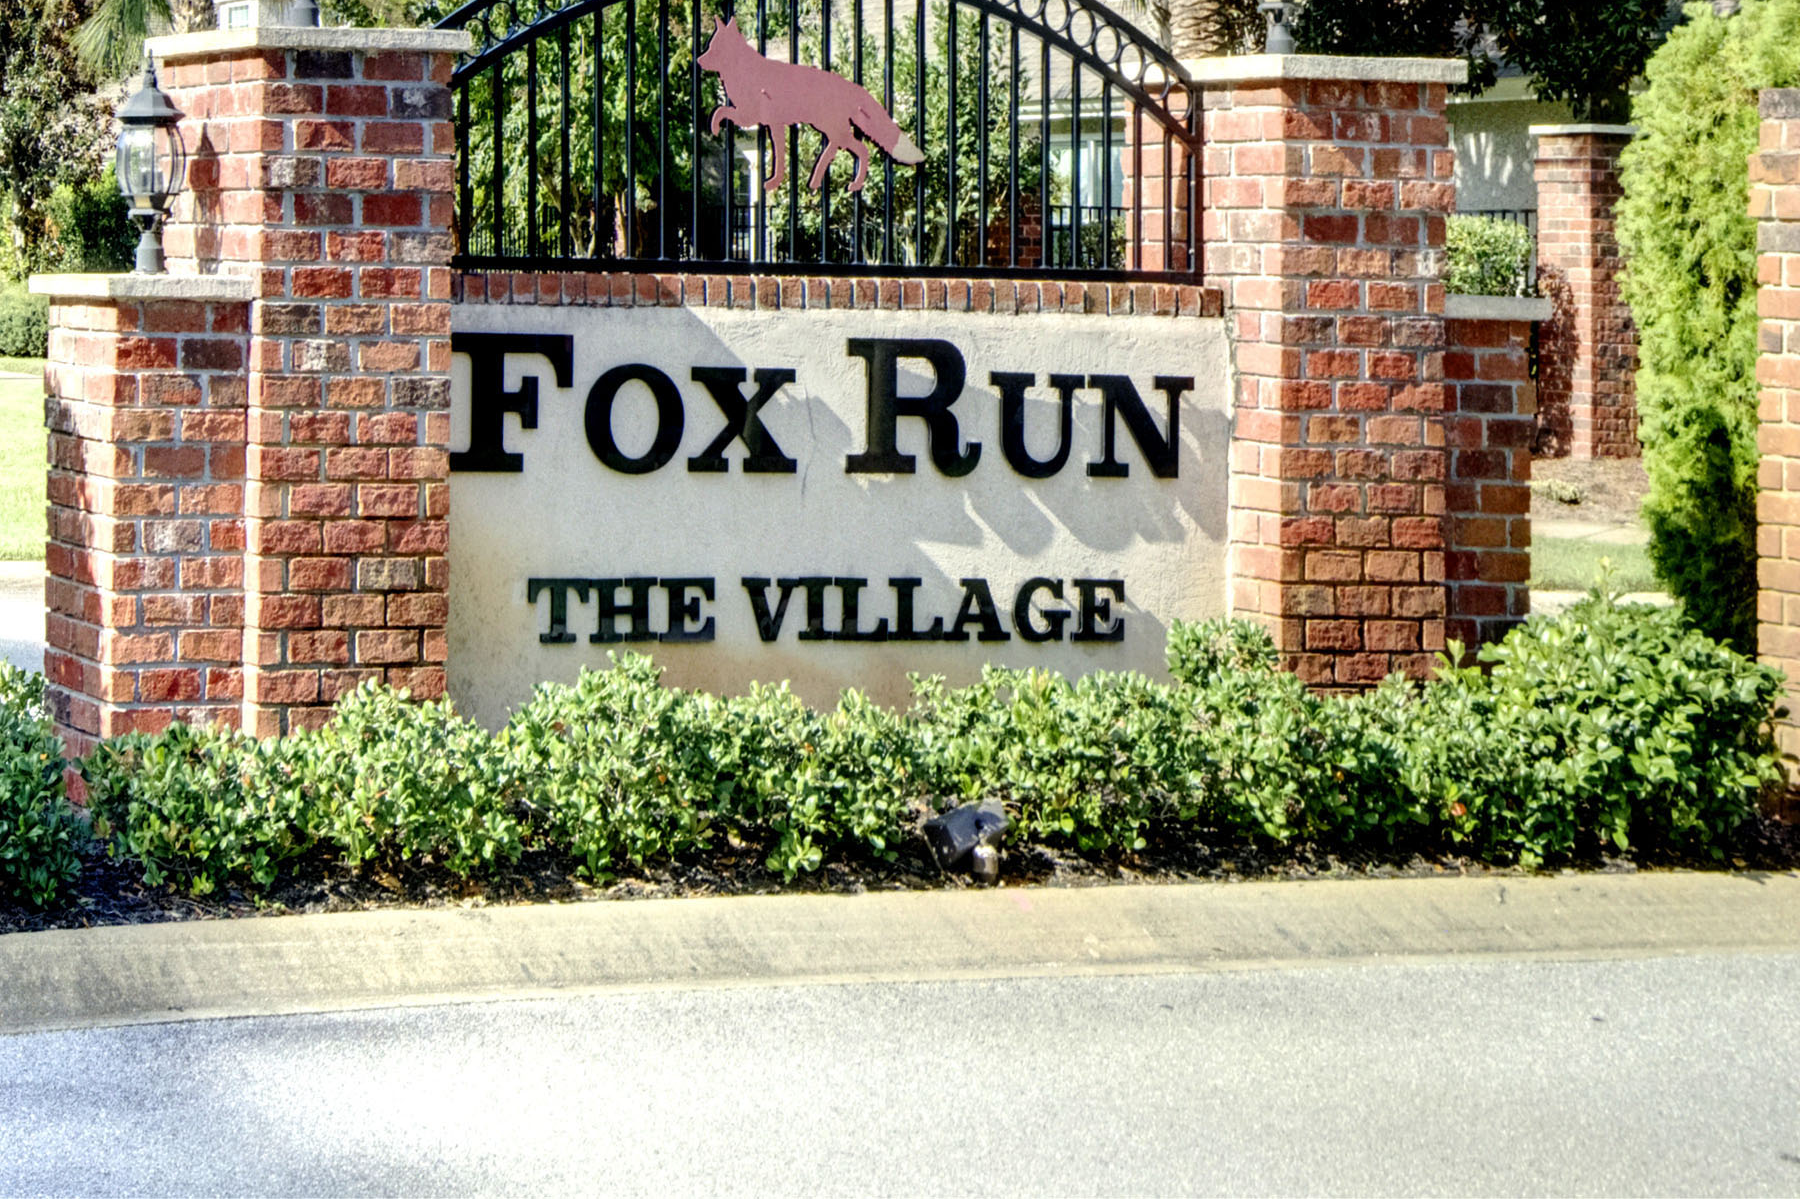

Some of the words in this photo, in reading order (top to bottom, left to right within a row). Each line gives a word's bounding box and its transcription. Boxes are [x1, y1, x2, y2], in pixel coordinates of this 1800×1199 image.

[450, 332, 798, 475] FOX
[845, 337, 1195, 479] RUN
[527, 577, 716, 644] THE
[741, 577, 1126, 643] VILLAGE
